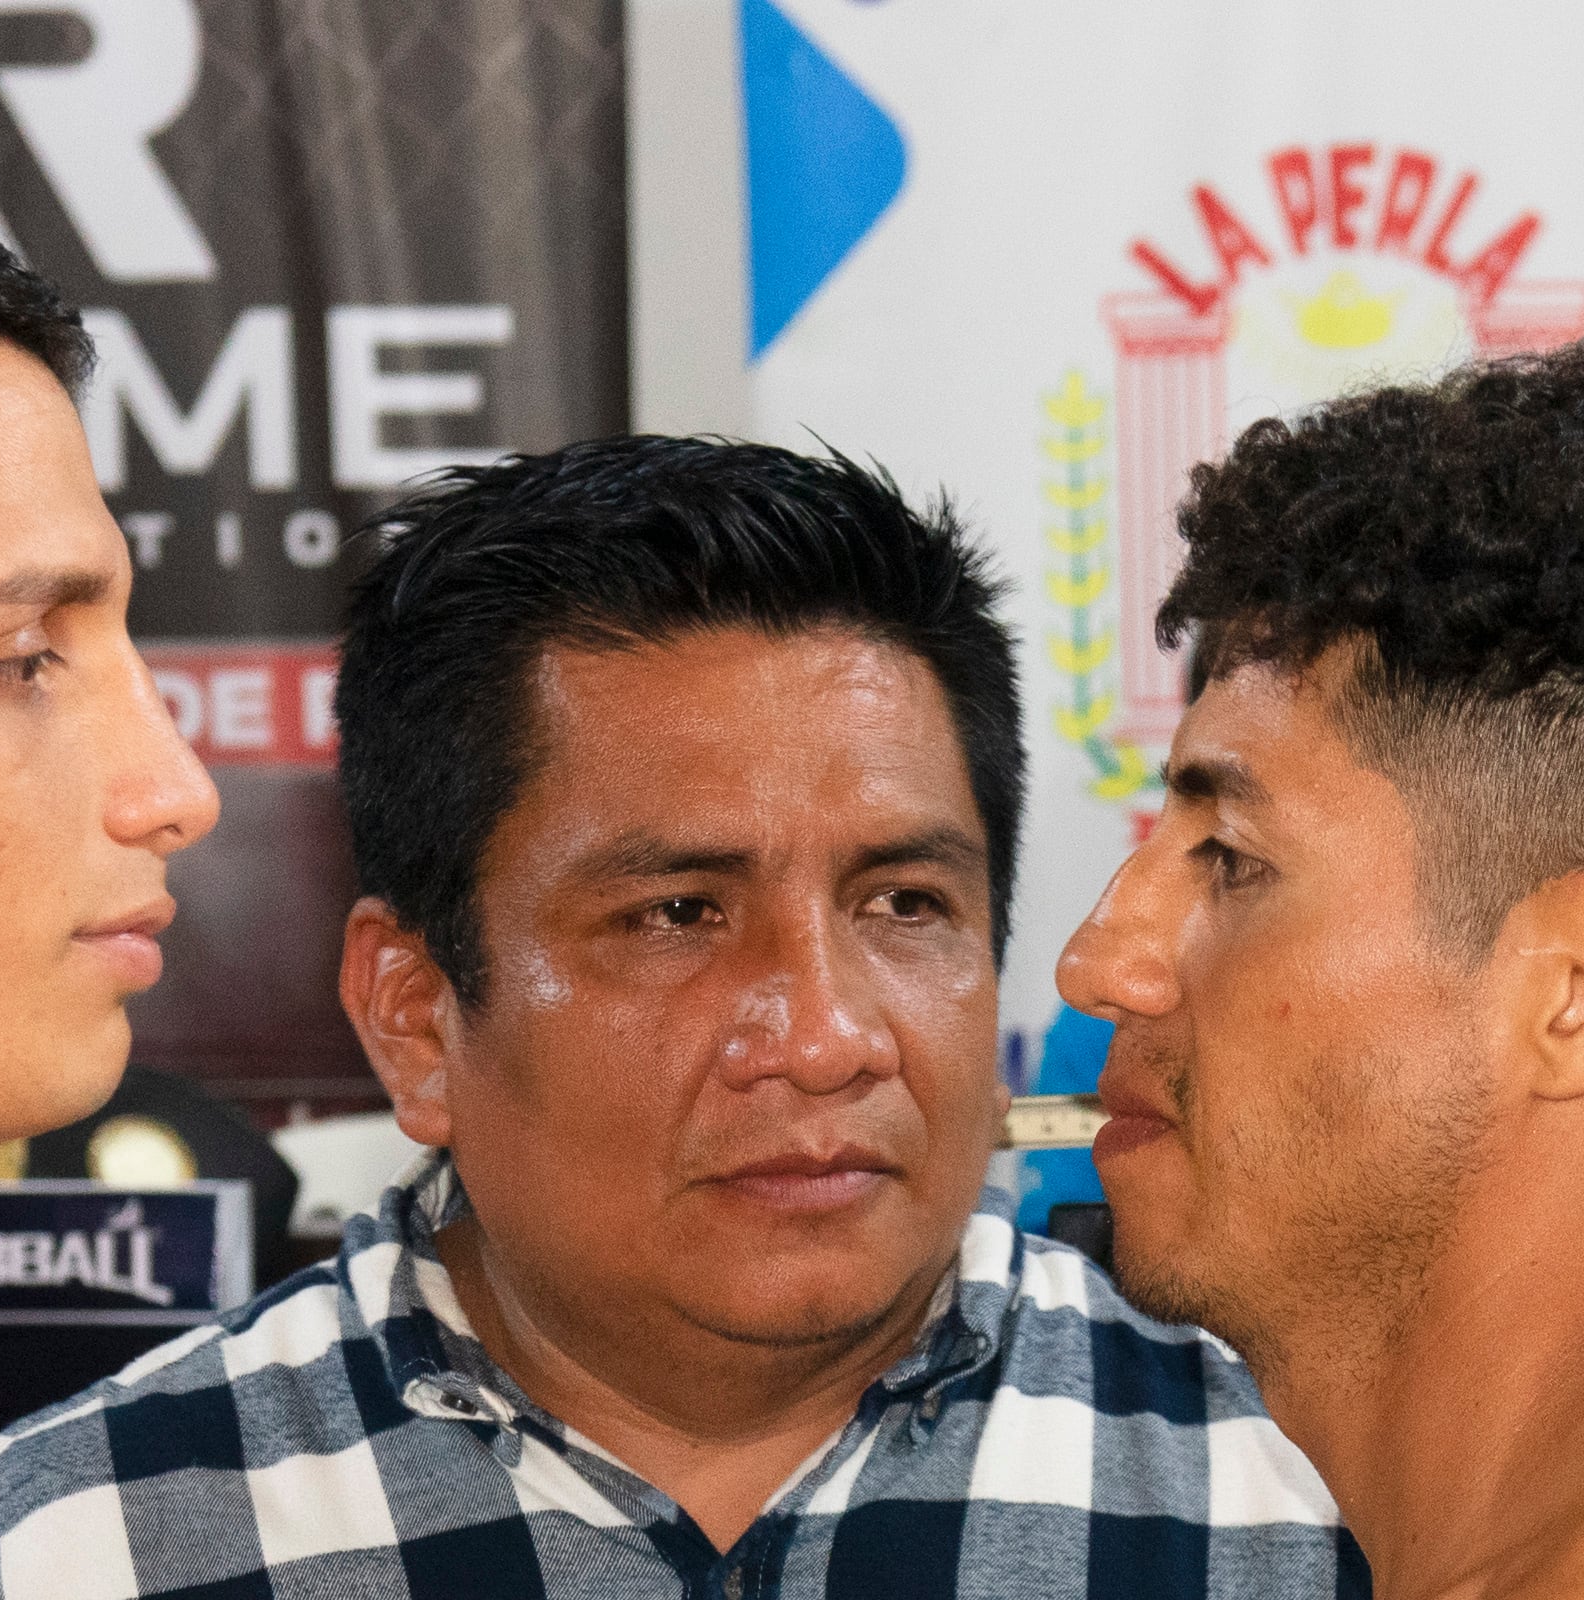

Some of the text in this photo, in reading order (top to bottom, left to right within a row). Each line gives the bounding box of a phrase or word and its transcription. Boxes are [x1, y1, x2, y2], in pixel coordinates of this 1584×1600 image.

[1129, 141, 1546, 317] LA PERLA
[121, 511, 416, 570] TIO
